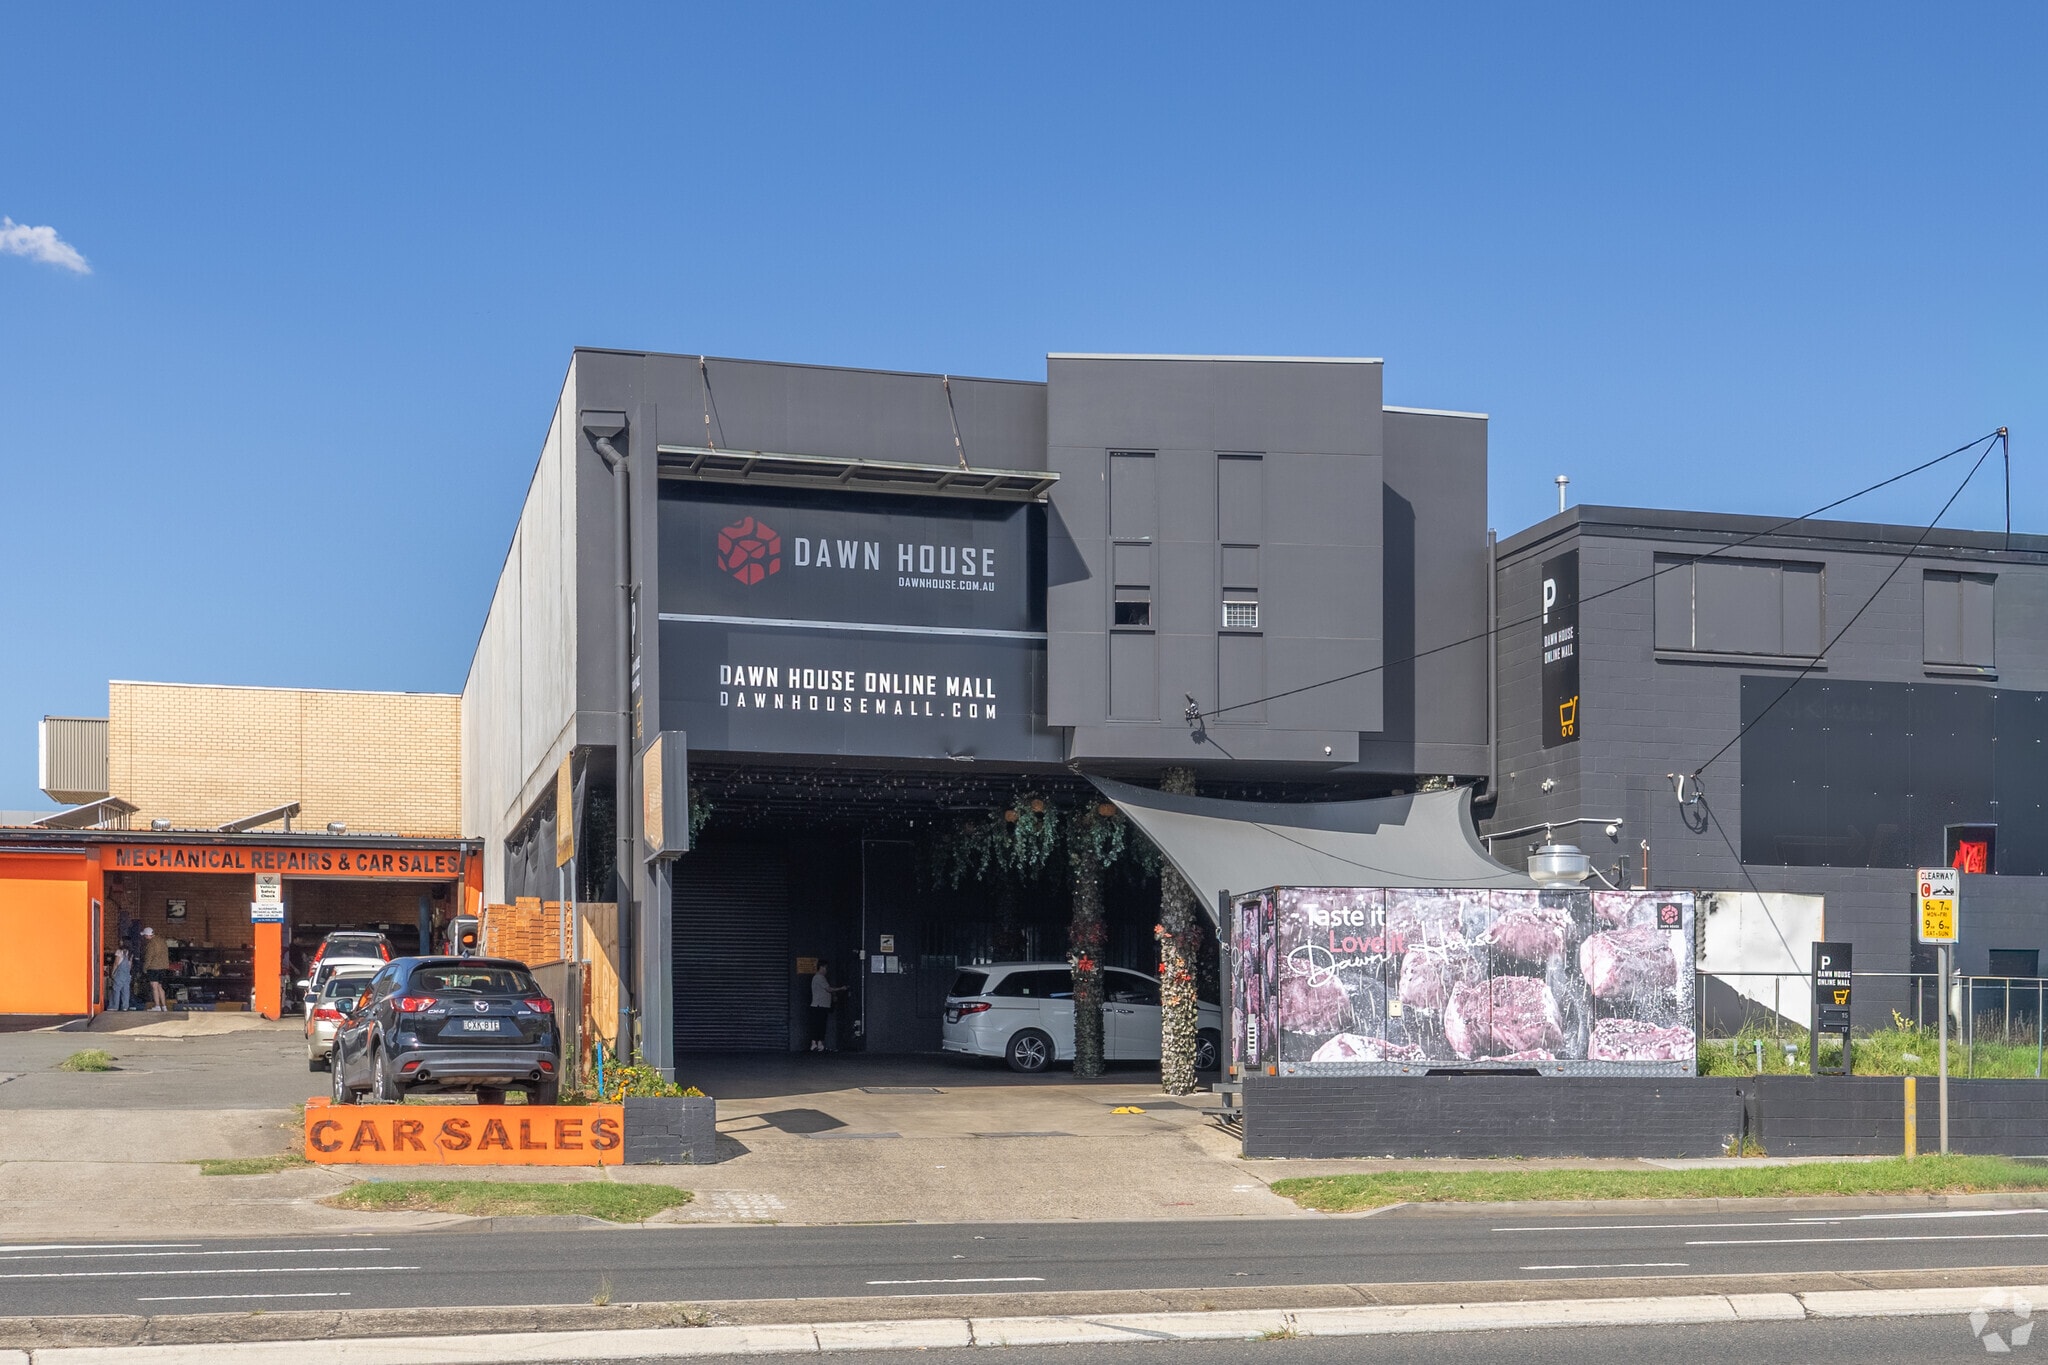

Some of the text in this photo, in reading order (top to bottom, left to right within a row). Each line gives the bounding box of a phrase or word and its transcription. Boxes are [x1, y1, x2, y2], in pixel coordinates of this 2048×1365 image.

[794, 537, 995, 577] DAWN HOUSE
[898, 576, 995, 592] DAWNHOUSE.COM.AU
[1543, 578, 1557, 625] P
[720, 664, 996, 699] DAWN HOUSE ONLINE MALL
[720, 691, 997, 720] DAWNHOUSEMALL.COM
[115, 848, 459, 873] MECHANICAL REPAIRS & CAR SALES
[1920, 872, 1954, 880] CLEARWAY
[1303, 904, 1385, 927] Taste it
[1287, 940, 1393, 988] Dawn
[1408, 919, 1501, 965] House
[1329, 930, 1385, 953] Love
[1821, 956, 1831, 970] P
[309, 1118, 621, 1153] CAR SALES
